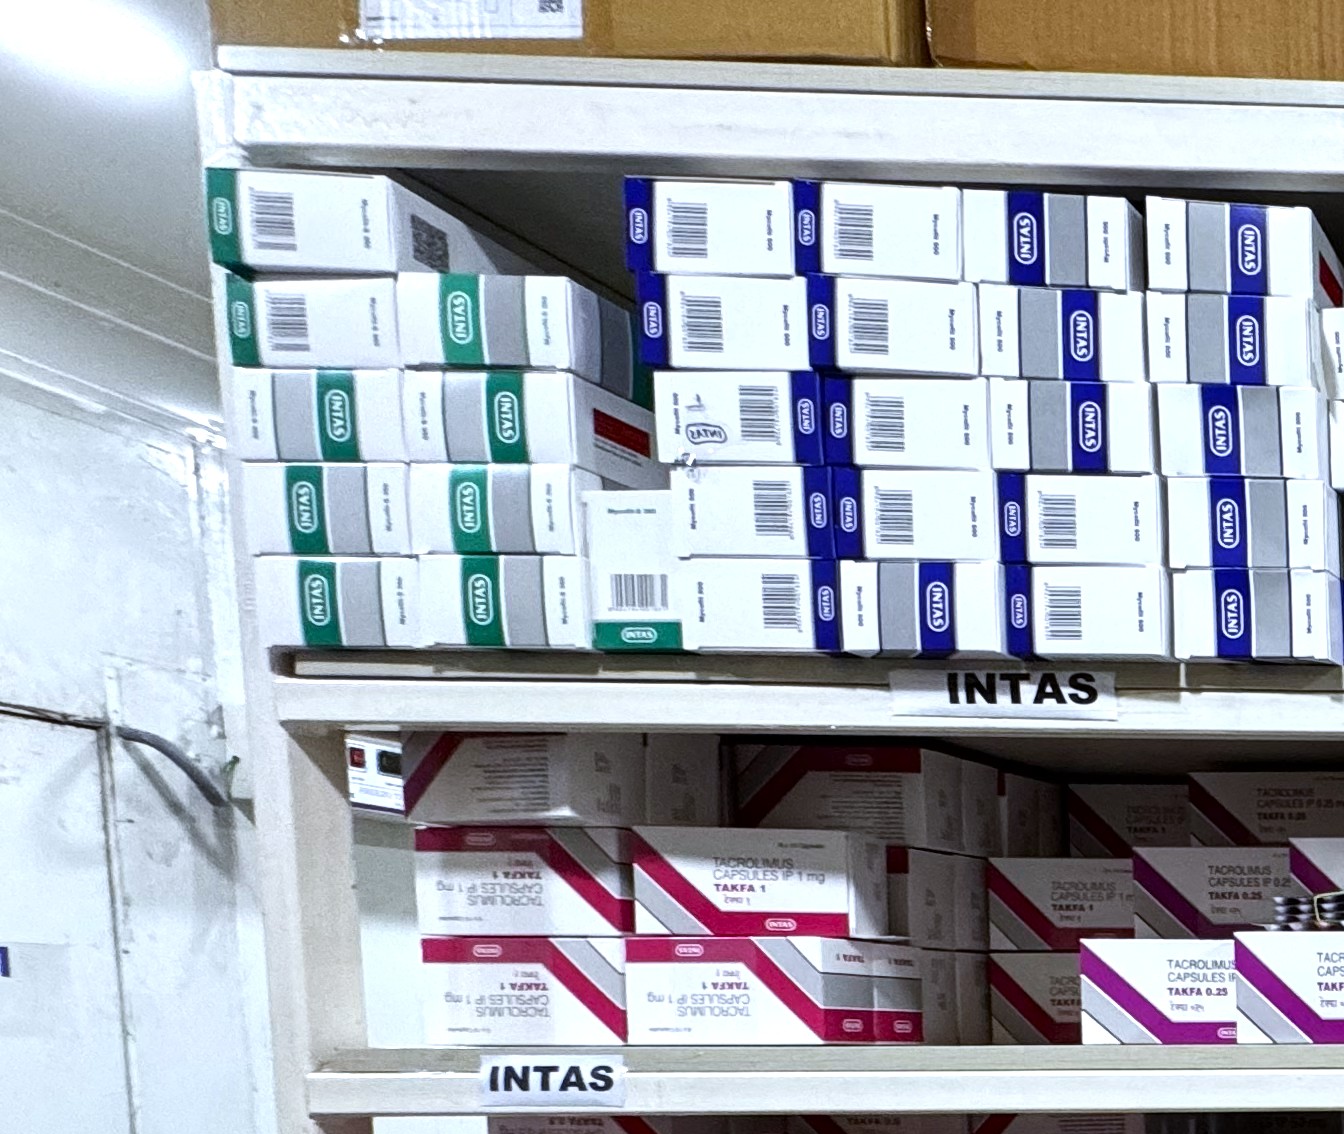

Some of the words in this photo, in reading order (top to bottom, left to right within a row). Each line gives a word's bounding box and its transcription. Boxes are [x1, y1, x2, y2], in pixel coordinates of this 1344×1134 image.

[1018, 215, 1033, 261] INTAS
[1242, 227, 1258, 272] INTAS
[1073, 314, 1090, 358] INTAS
[1239, 318, 1256, 363] INTAS
[1081, 404, 1098, 450] INTAS
[1212, 409, 1228, 453] INTAS
[1220, 502, 1236, 545] INTAS
[930, 585, 945, 629] INTAS
[1226, 592, 1240, 636] INTAS
[950, 672, 1097, 708] INTAS
[713, 857, 794, 869] TACROLIMUS
[714, 884, 756, 893] TAKFA
[760, 884, 766, 893] 1
[1167, 988, 1202, 996] TAKFA
[1205, 988, 1228, 997] 0.25
[490, 1065, 614, 1092] INTAS
